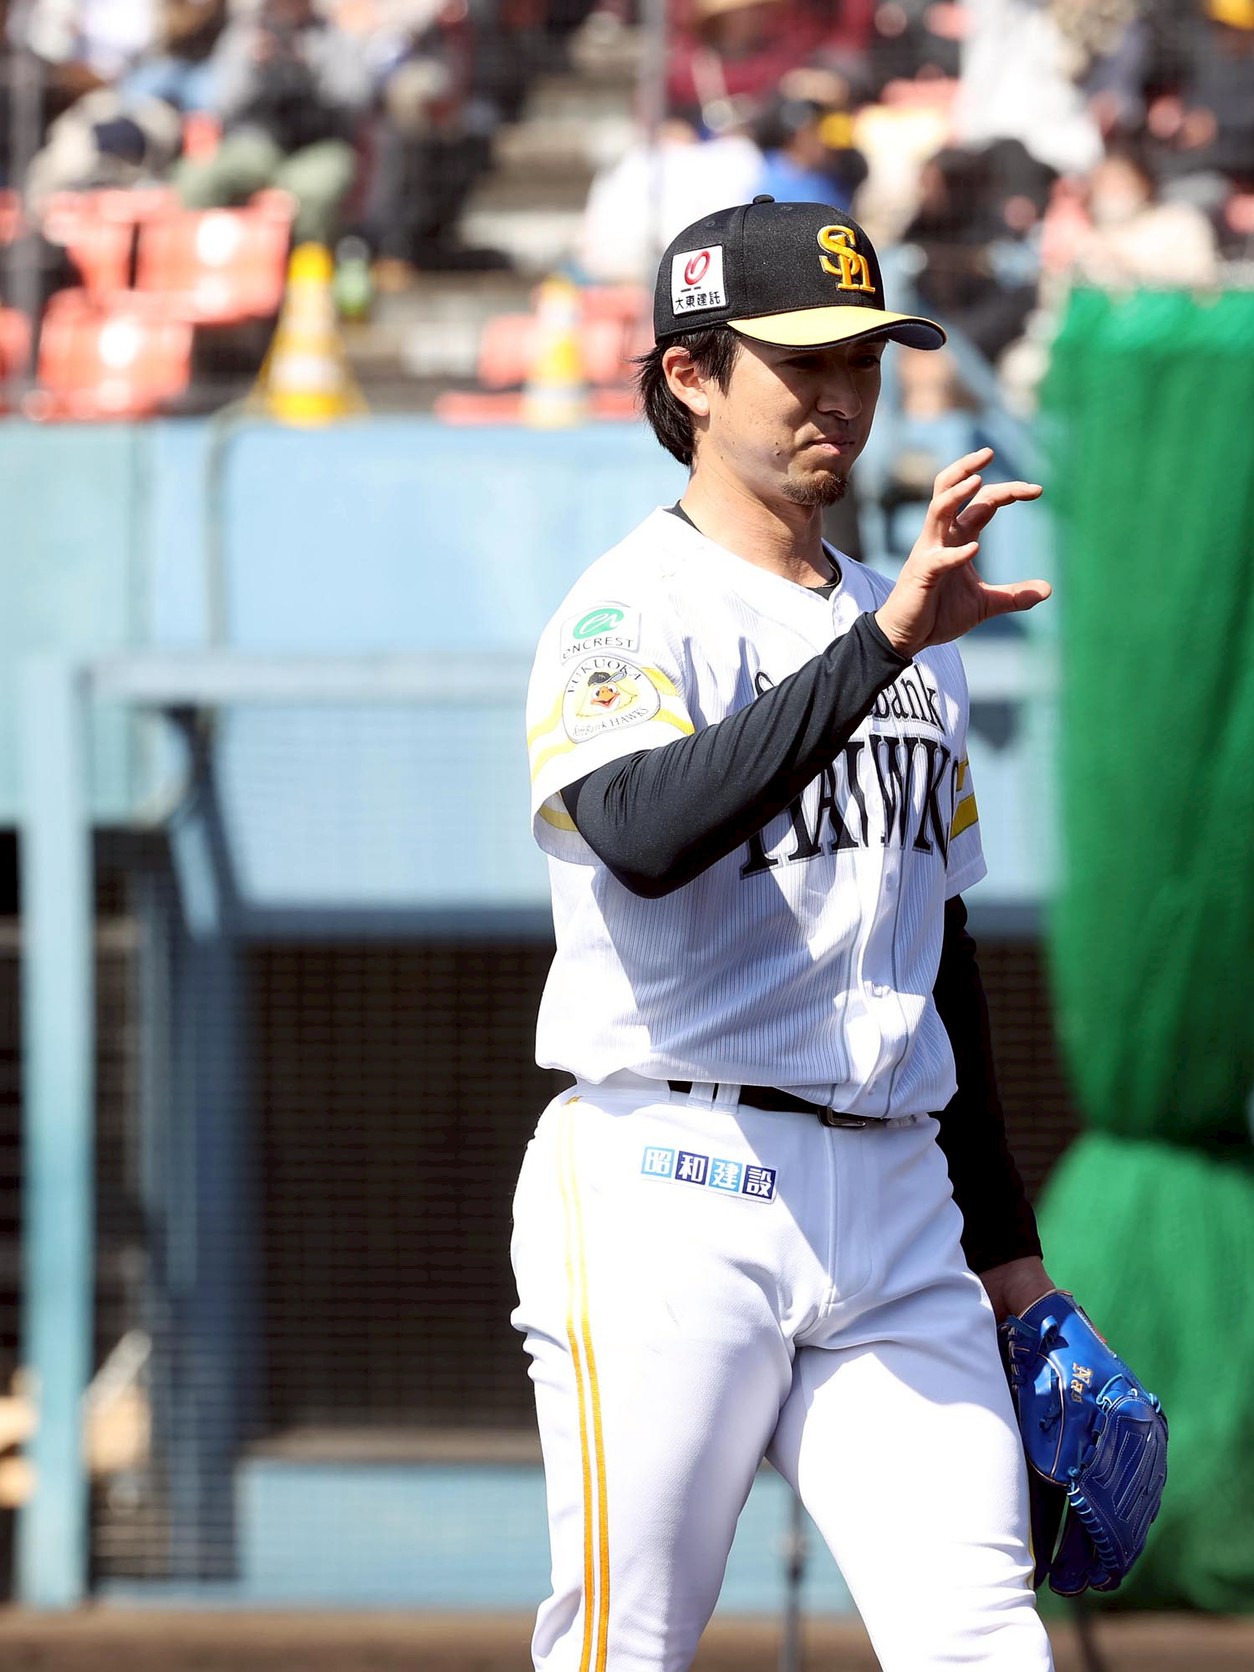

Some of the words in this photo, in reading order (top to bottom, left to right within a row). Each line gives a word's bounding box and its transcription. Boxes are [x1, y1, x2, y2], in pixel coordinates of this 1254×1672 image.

[675, 291, 721, 310] 大東建託
[567, 659, 642, 693] FUKUOKA
[642, 1147, 776, 1199] 昭和建設
